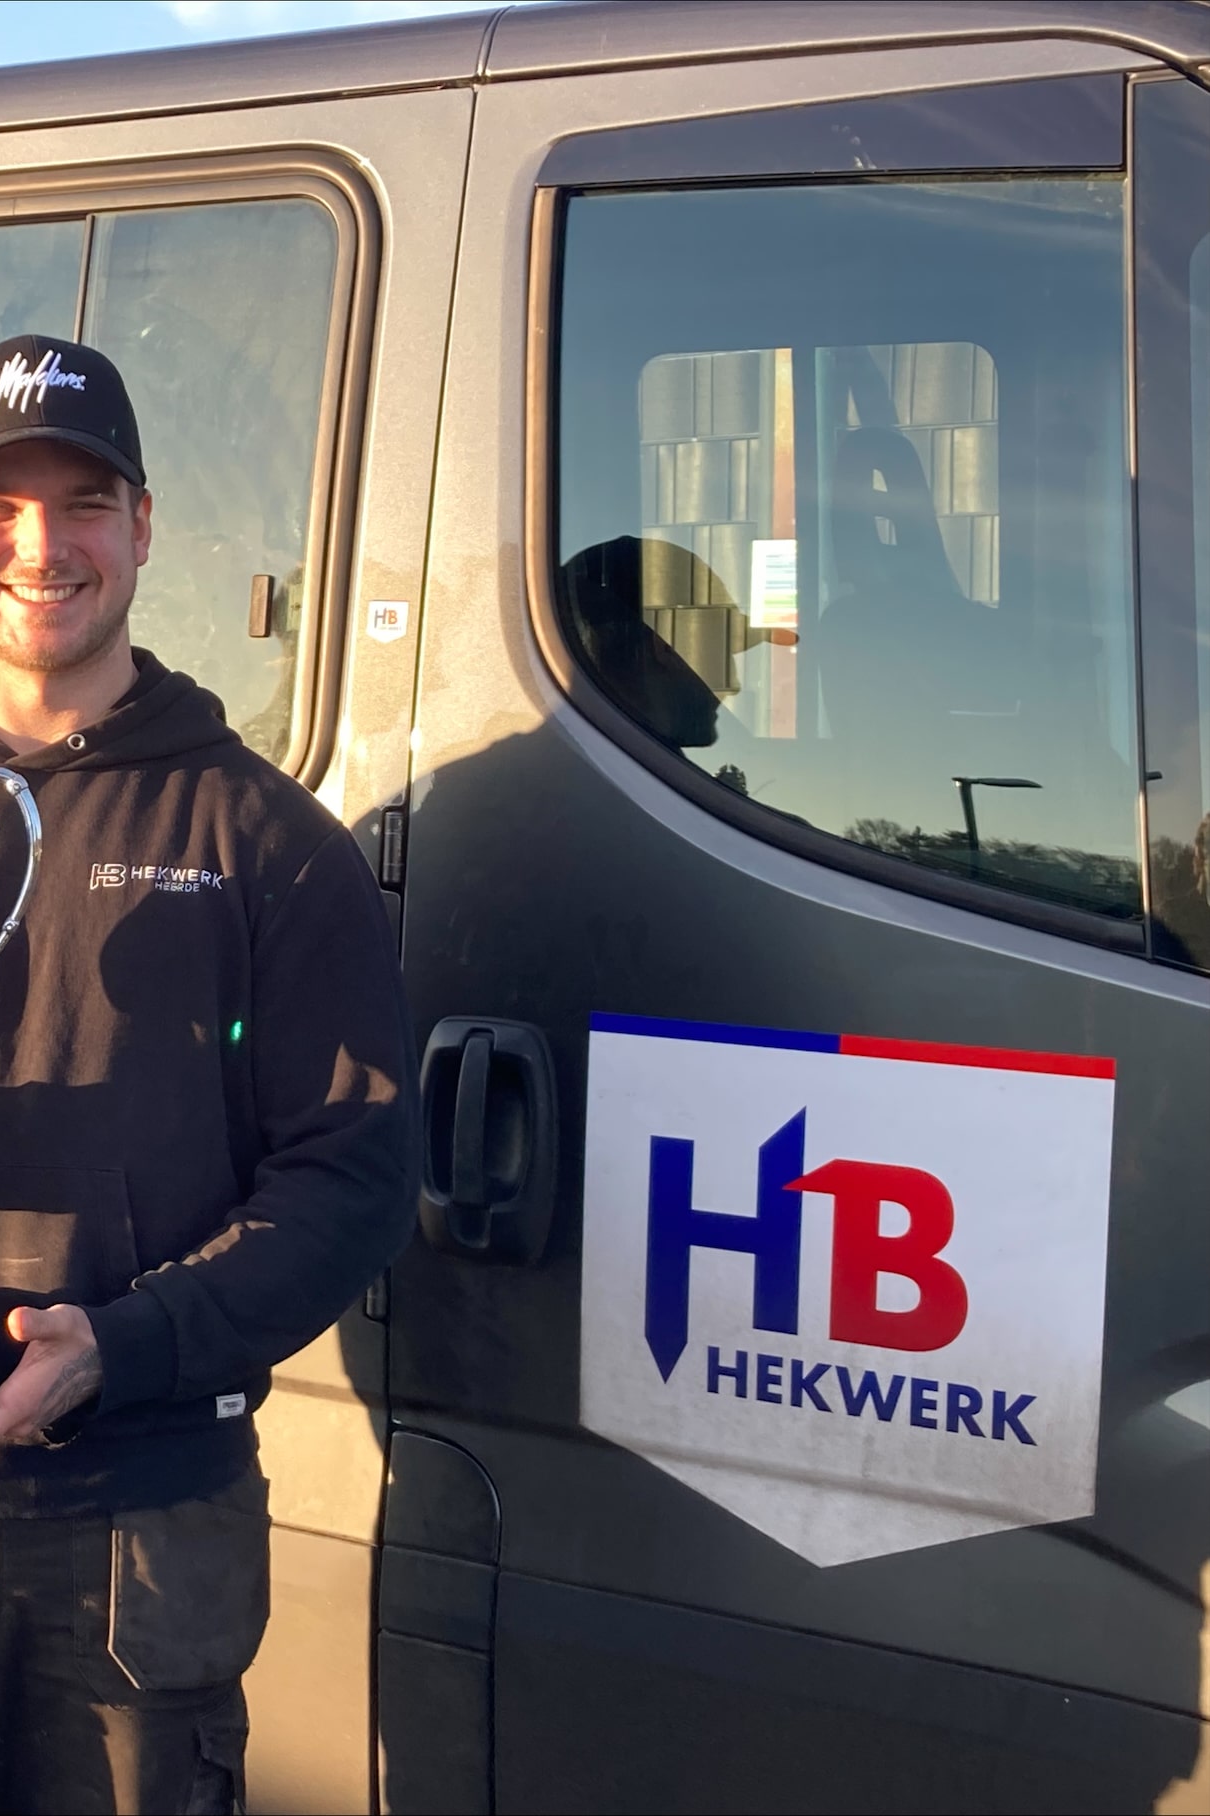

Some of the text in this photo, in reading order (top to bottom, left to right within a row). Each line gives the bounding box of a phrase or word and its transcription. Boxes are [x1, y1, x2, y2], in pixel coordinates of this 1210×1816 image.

[373, 607, 398, 628] HB
[130, 865, 224, 890] HEKWERK
[155, 881, 200, 892] HEERDE
[645, 1106, 968, 1385] HB
[706, 1345, 1038, 1447] HEKWERK
